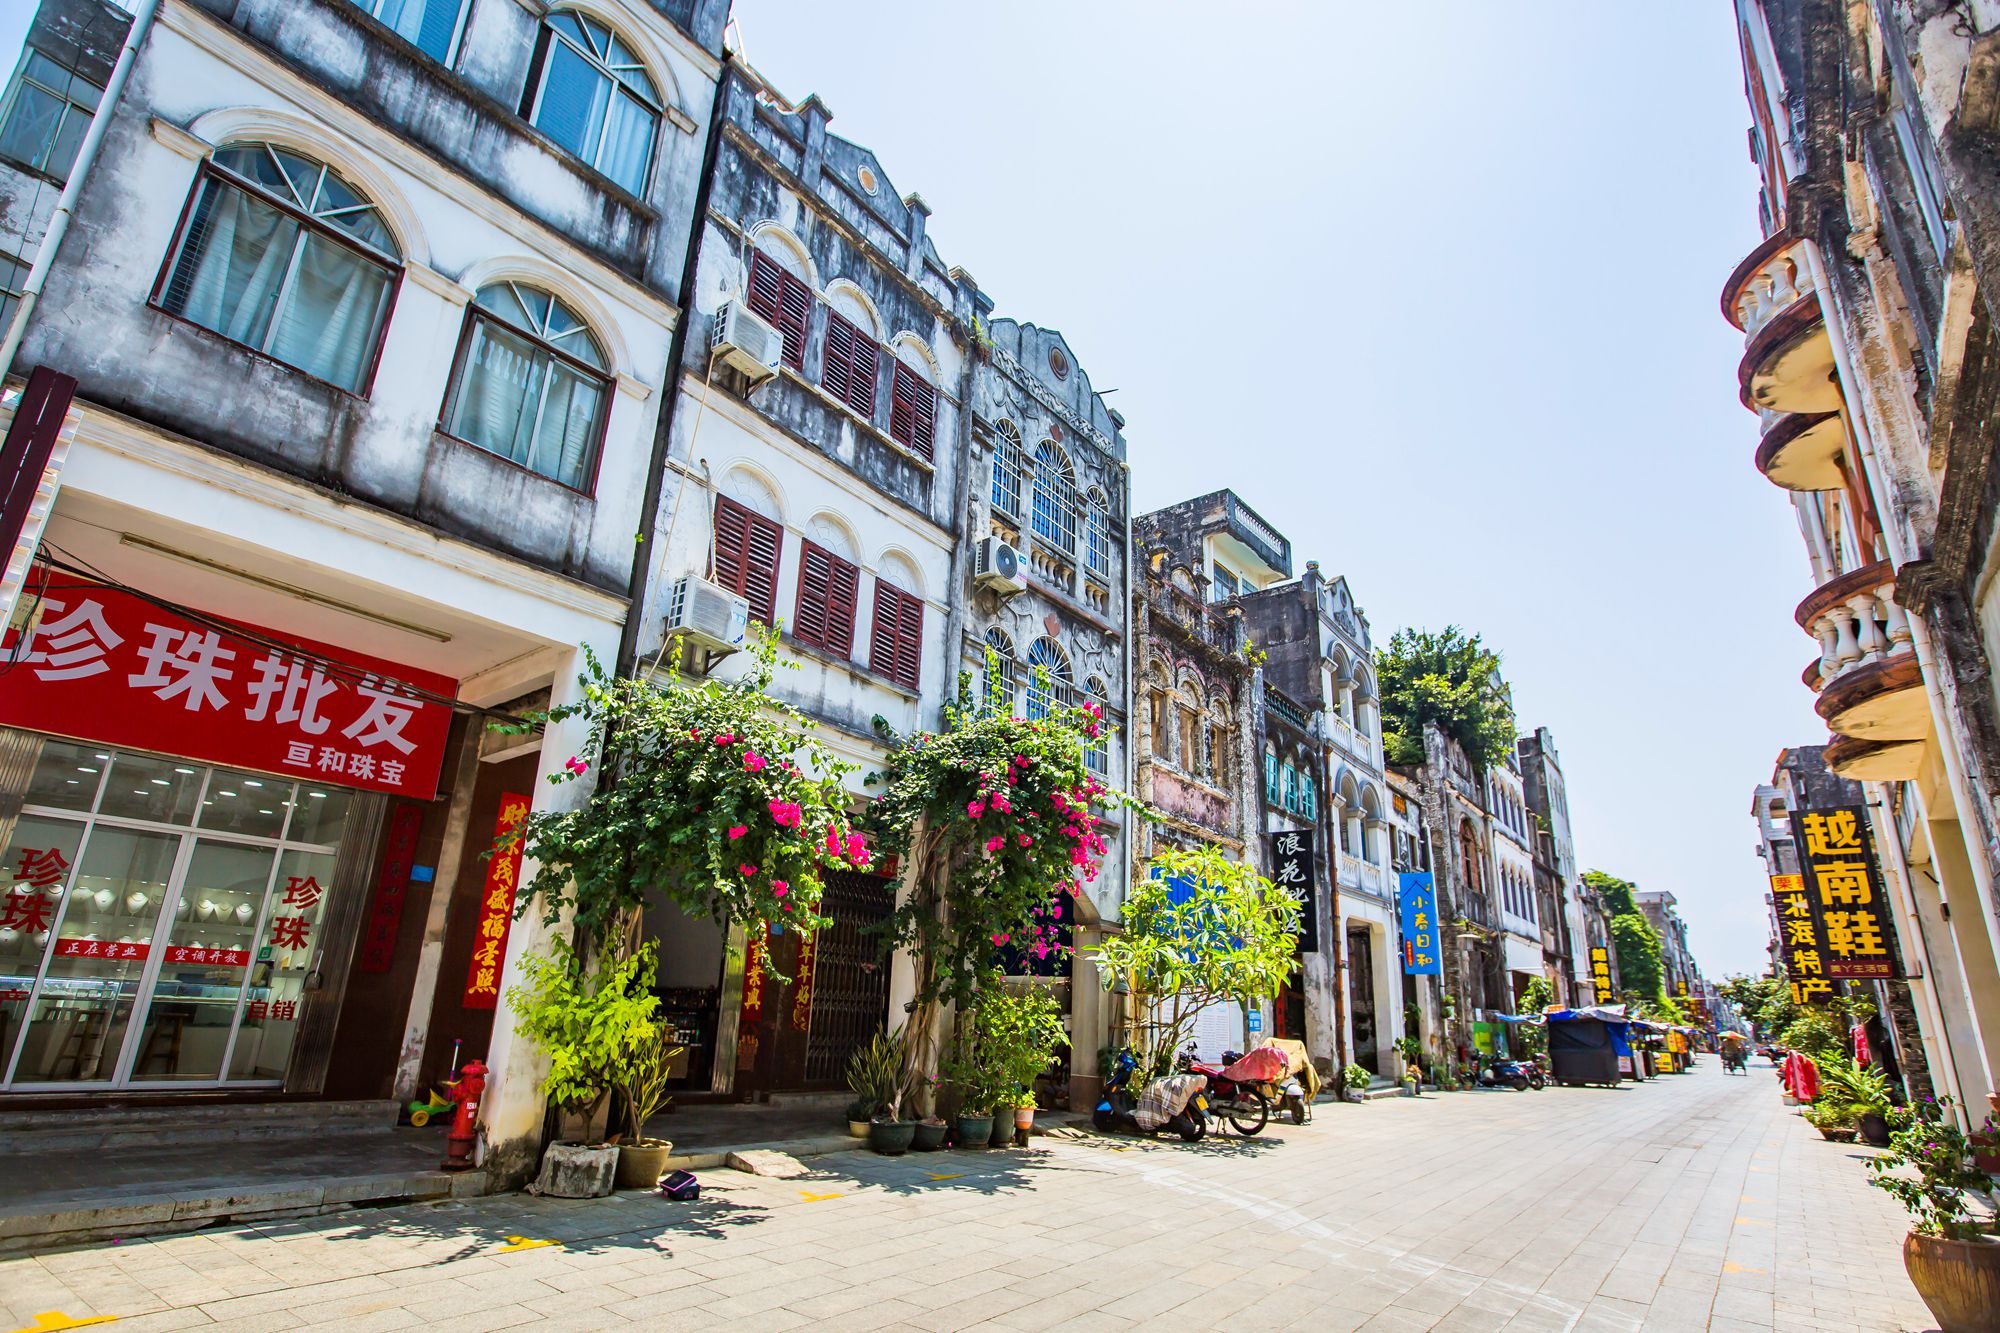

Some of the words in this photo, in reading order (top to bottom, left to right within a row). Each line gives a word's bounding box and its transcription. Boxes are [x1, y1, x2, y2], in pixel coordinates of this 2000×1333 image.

[0, 598, 424, 756] 珍珠批发
[1, 847, 70, 934] 珍珠
[270, 875, 322, 951] 珍珠
[1803, 810, 1887, 957] 越南鞋
[65, 942, 137, 957] 正在营业
[175, 948, 238, 964] 空调开放
[1412, 896, 1433, 967] 小春日和
[1783, 893, 1832, 1003] 北海特产
[247, 999, 297, 1021] 自销
